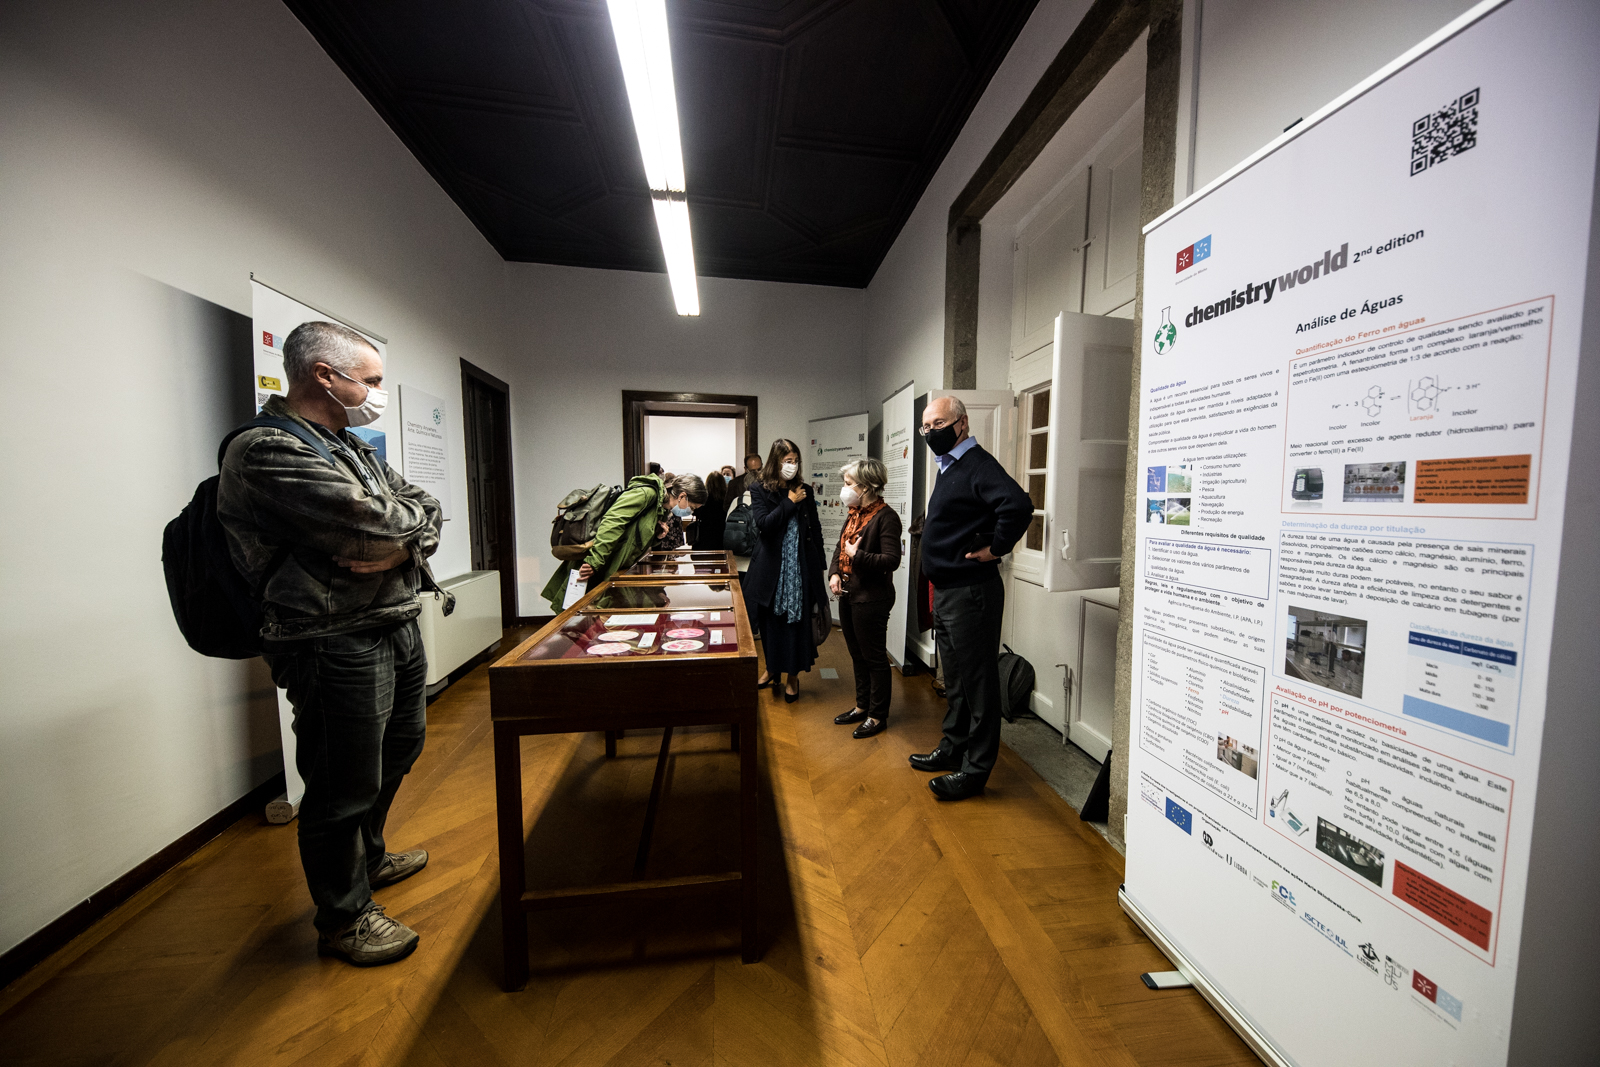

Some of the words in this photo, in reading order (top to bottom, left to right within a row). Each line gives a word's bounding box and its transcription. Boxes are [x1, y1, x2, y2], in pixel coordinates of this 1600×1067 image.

[1295, 314, 1336, 334] Análise
[1340, 308, 1356, 320] de
[1360, 294, 1403, 314] Águas
[1293, 363, 1338, 377] espetrofotometria.
[1350, 353, 1386, 365] fenantrolina
[1427, 336, 1464, 348] complexo
[1469, 318, 1543, 339] laranja/vermelho
[1296, 338, 1343, 355] Quantificação
[1358, 329, 1380, 339] Ferro
[1383, 325, 1395, 333] em
[1398, 316, 1426, 329] águas
[1308, 355, 1335, 366] parâmetro
[1338, 348, 1365, 359] indicador
[1378, 339, 1404, 350] controlo
[1418, 327, 1454, 341] qualidade
[1458, 321, 1483, 332] sendo
[1487, 310, 1524, 324] avaliado
[1528, 306, 1544, 316] por
[1309, 375, 1323, 383] Fe(II)
[1351, 358, 1397, 374] estequiometria
[1433, 347, 1460, 357] acordo
[1463, 342, 1480, 351] com
[1490, 334, 1523, 345] reação:
[1447, 424, 1508, 436] (hidroxilamina)
[1513, 421, 1535, 430] para
[1282, 521, 1328, 529] Determinação
[1386, 526, 1425, 534] titulação
[1416, 542, 1450, 551] presença
[1311, 543, 1350, 552] principalmente
[1419, 552, 1458, 561] magnésio,
[1460, 556, 1498, 564] alumínio,
[1501, 559, 1525, 567] ferro,
[1276, 685, 1306, 700] Avaliação
[1330, 705, 1343, 713] por
[1345, 709, 1406, 736] potenciometria
[1356, 954, 1379, 974] LISBOA
